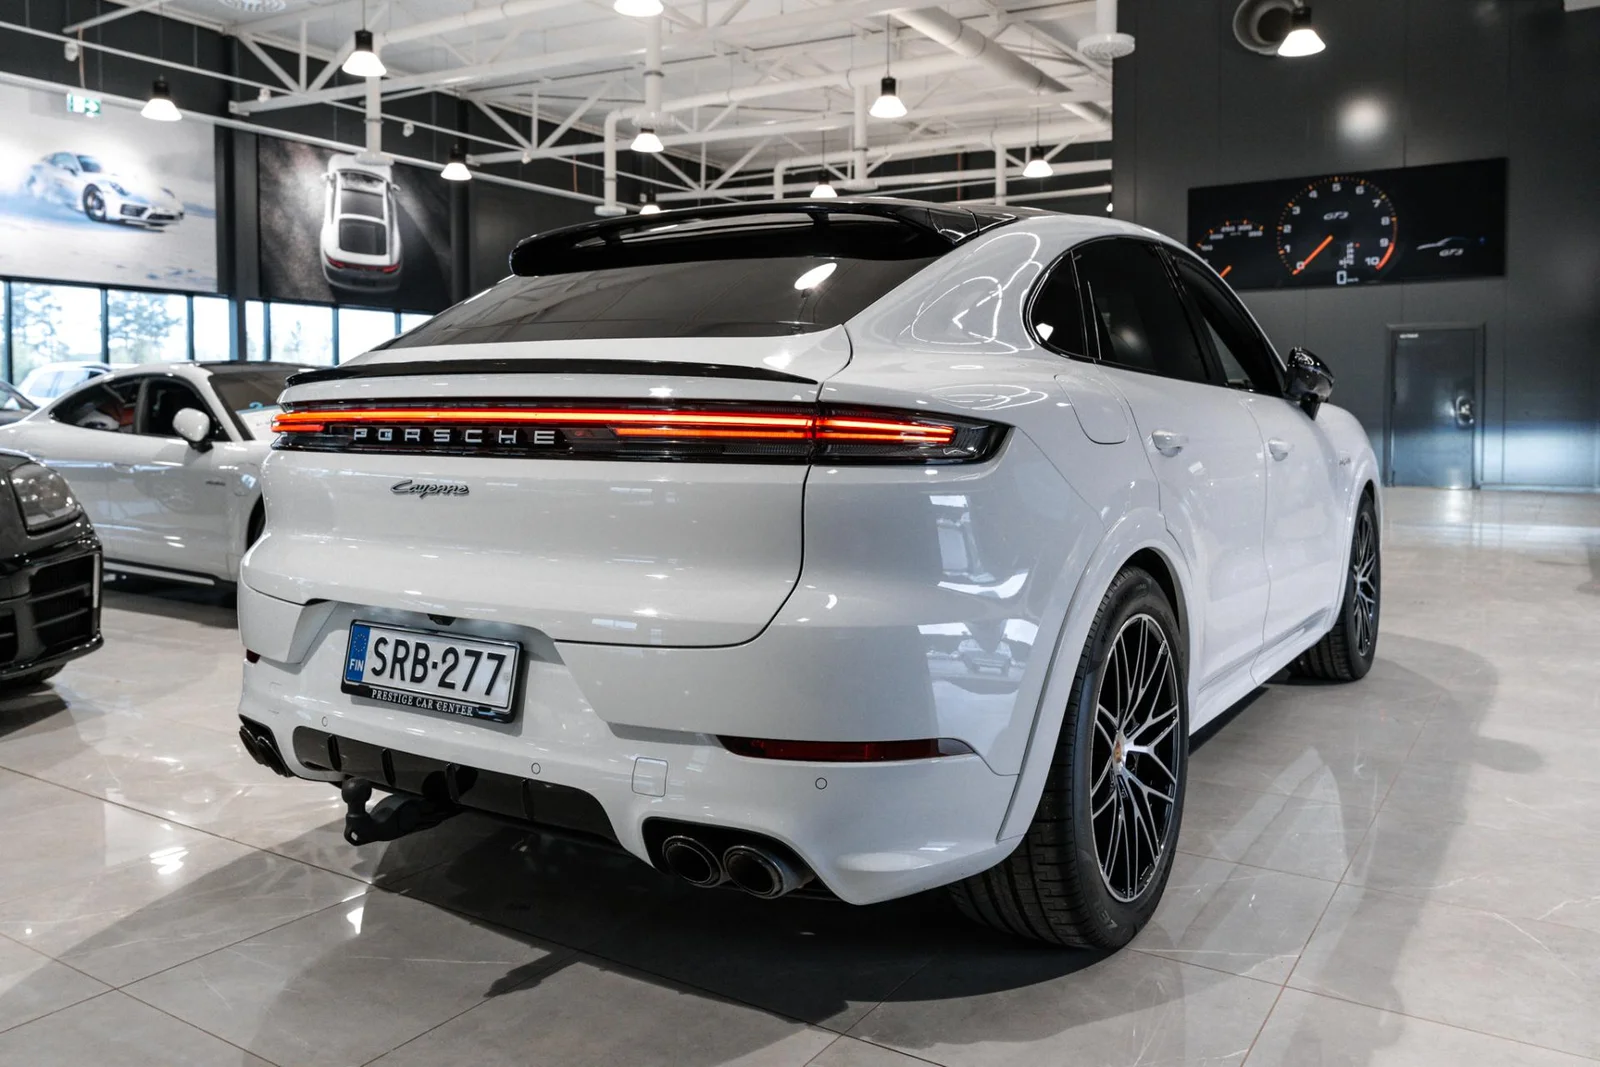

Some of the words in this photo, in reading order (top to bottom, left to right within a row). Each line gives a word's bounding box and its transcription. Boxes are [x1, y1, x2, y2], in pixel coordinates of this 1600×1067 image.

[1332, 183, 1341, 192] 5
[1355, 186, 1364, 195] 6
[1308, 190, 1318, 199] 4
[1372, 199, 1381, 208] 7
[1292, 206, 1301, 215] 3
[1283, 224, 1292, 233] 2
[1284, 244, 1291, 253] 1
[1365, 256, 1380, 266] 10
[353, 428, 555, 445] PORSCHE
[391, 479, 470, 499] Cayenne
[349, 658, 364, 672] FIN
[371, 689, 413, 705] PRESTIGE
[416, 697, 433, 709] CAR
[436, 701, 474, 716] CENTER
